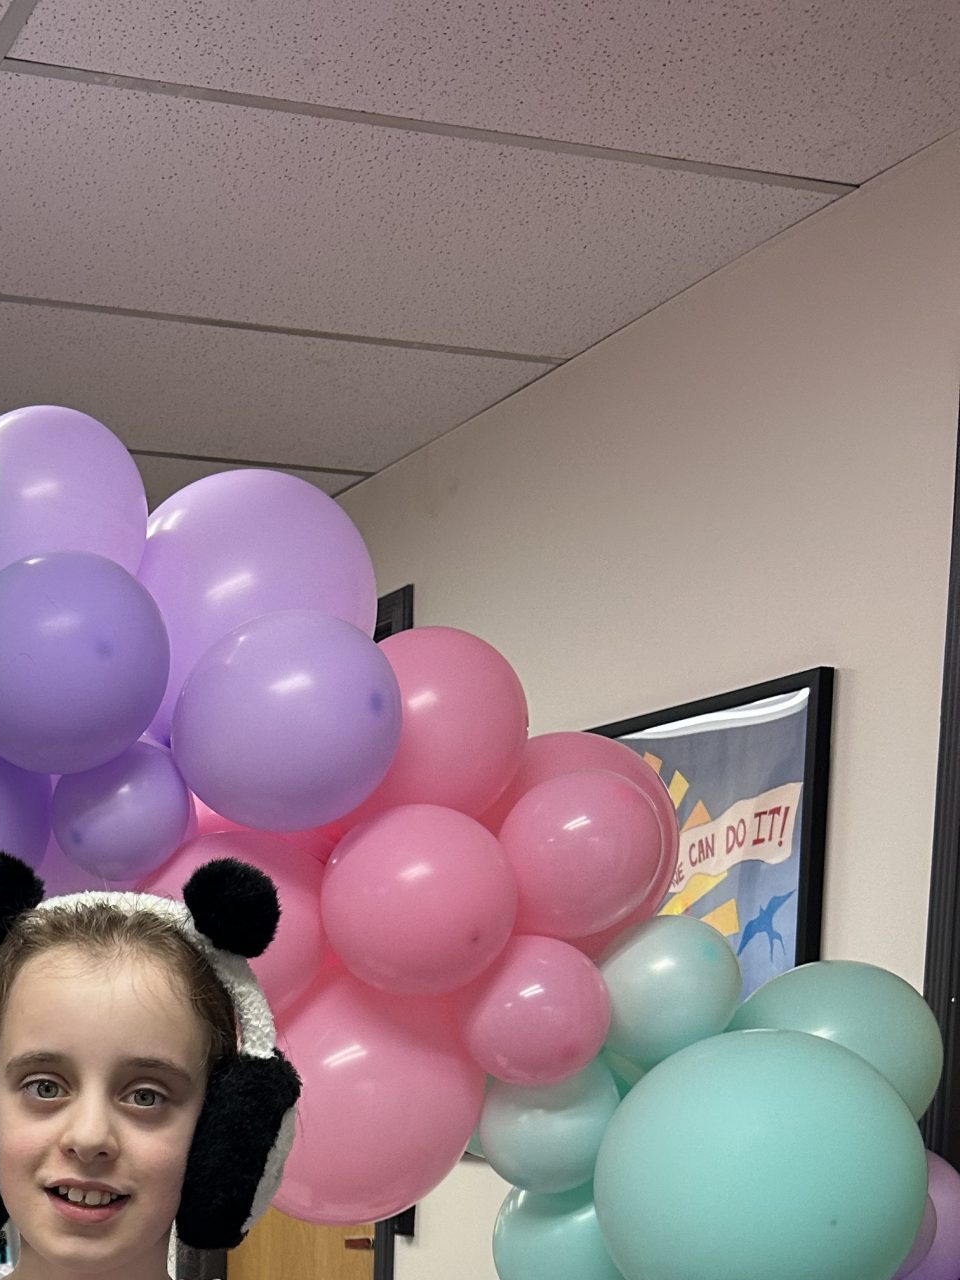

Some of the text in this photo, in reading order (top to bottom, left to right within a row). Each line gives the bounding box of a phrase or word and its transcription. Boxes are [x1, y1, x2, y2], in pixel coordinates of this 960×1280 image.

[688, 833, 715, 867] CAN
[726, 818, 746, 855] DO
[752, 806, 790, 847] IT!
